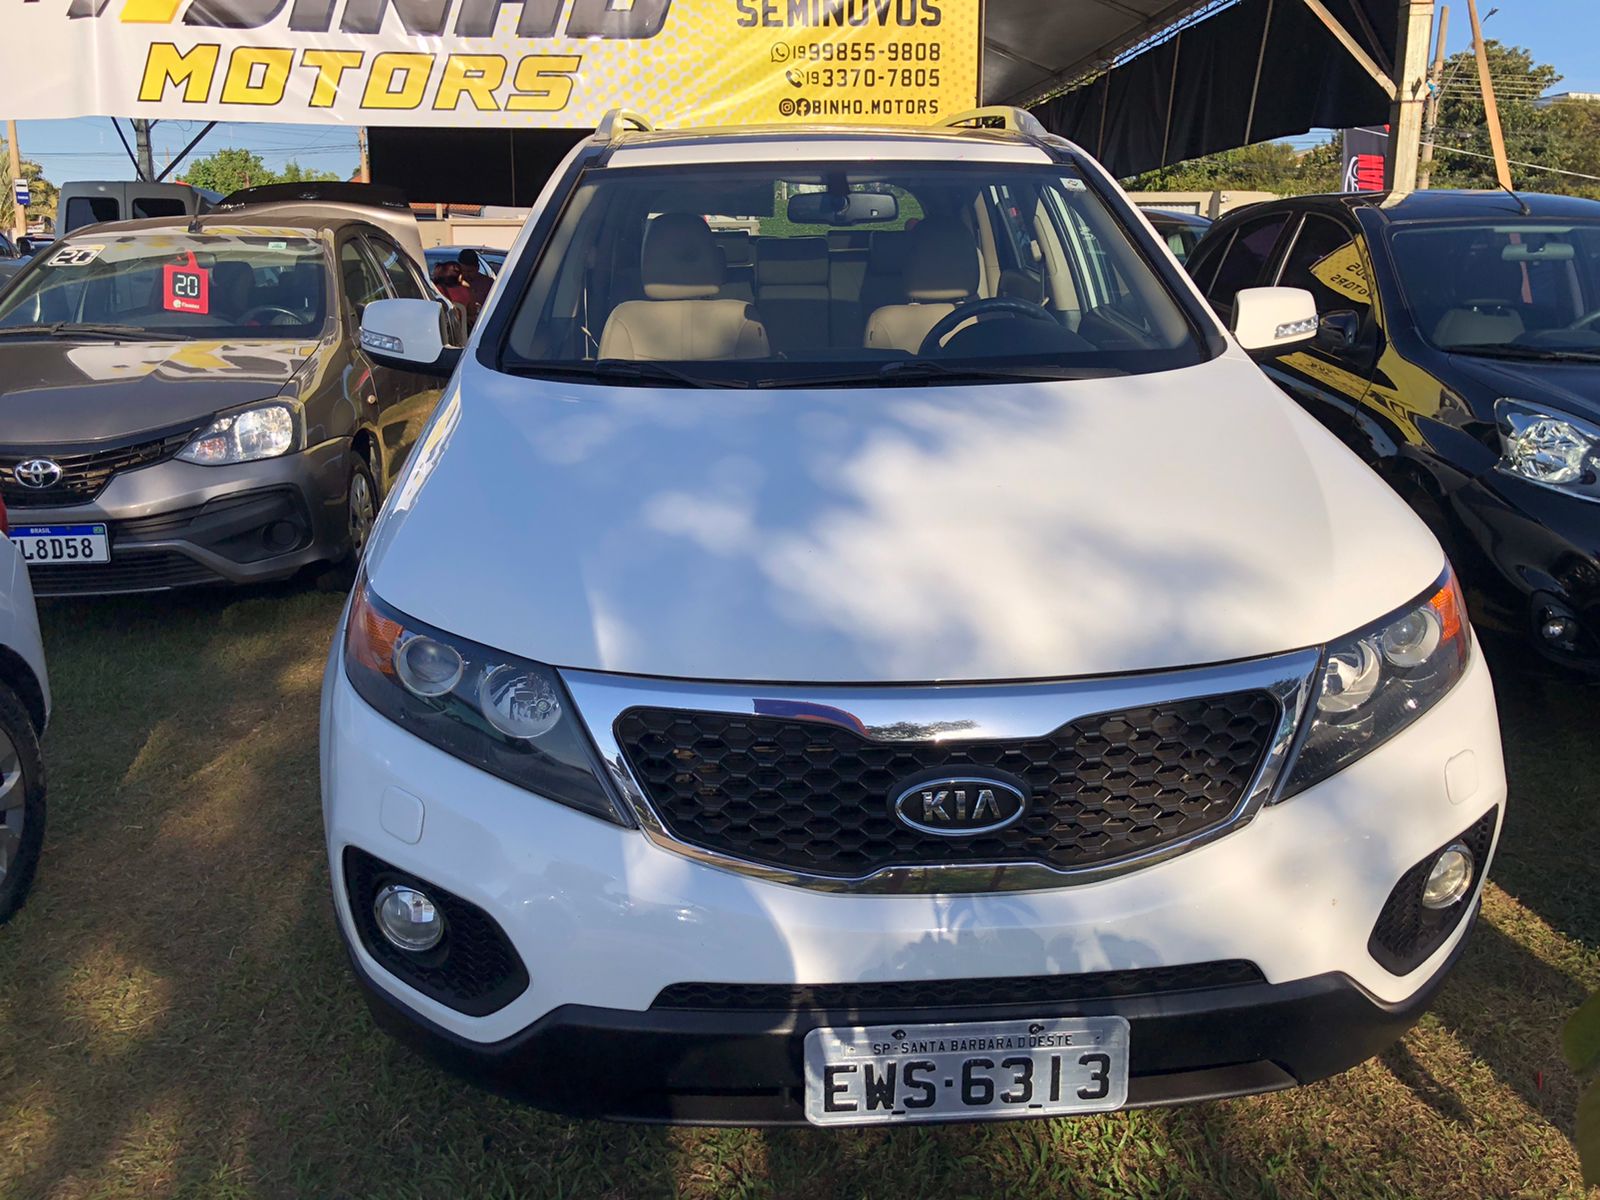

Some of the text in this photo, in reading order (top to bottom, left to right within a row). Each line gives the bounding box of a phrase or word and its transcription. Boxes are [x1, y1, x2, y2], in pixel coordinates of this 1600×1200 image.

[737, 0, 942, 27] SEMINOVOS
[137, 41, 582, 112] MOTORS
[50, 249, 99, 265] 20
[175, 274, 198, 296] 20
[11, 537, 94, 561] L8D58
[921, 789, 1001, 821] KIA
[950, 1036, 1013, 1052] BARBARA
